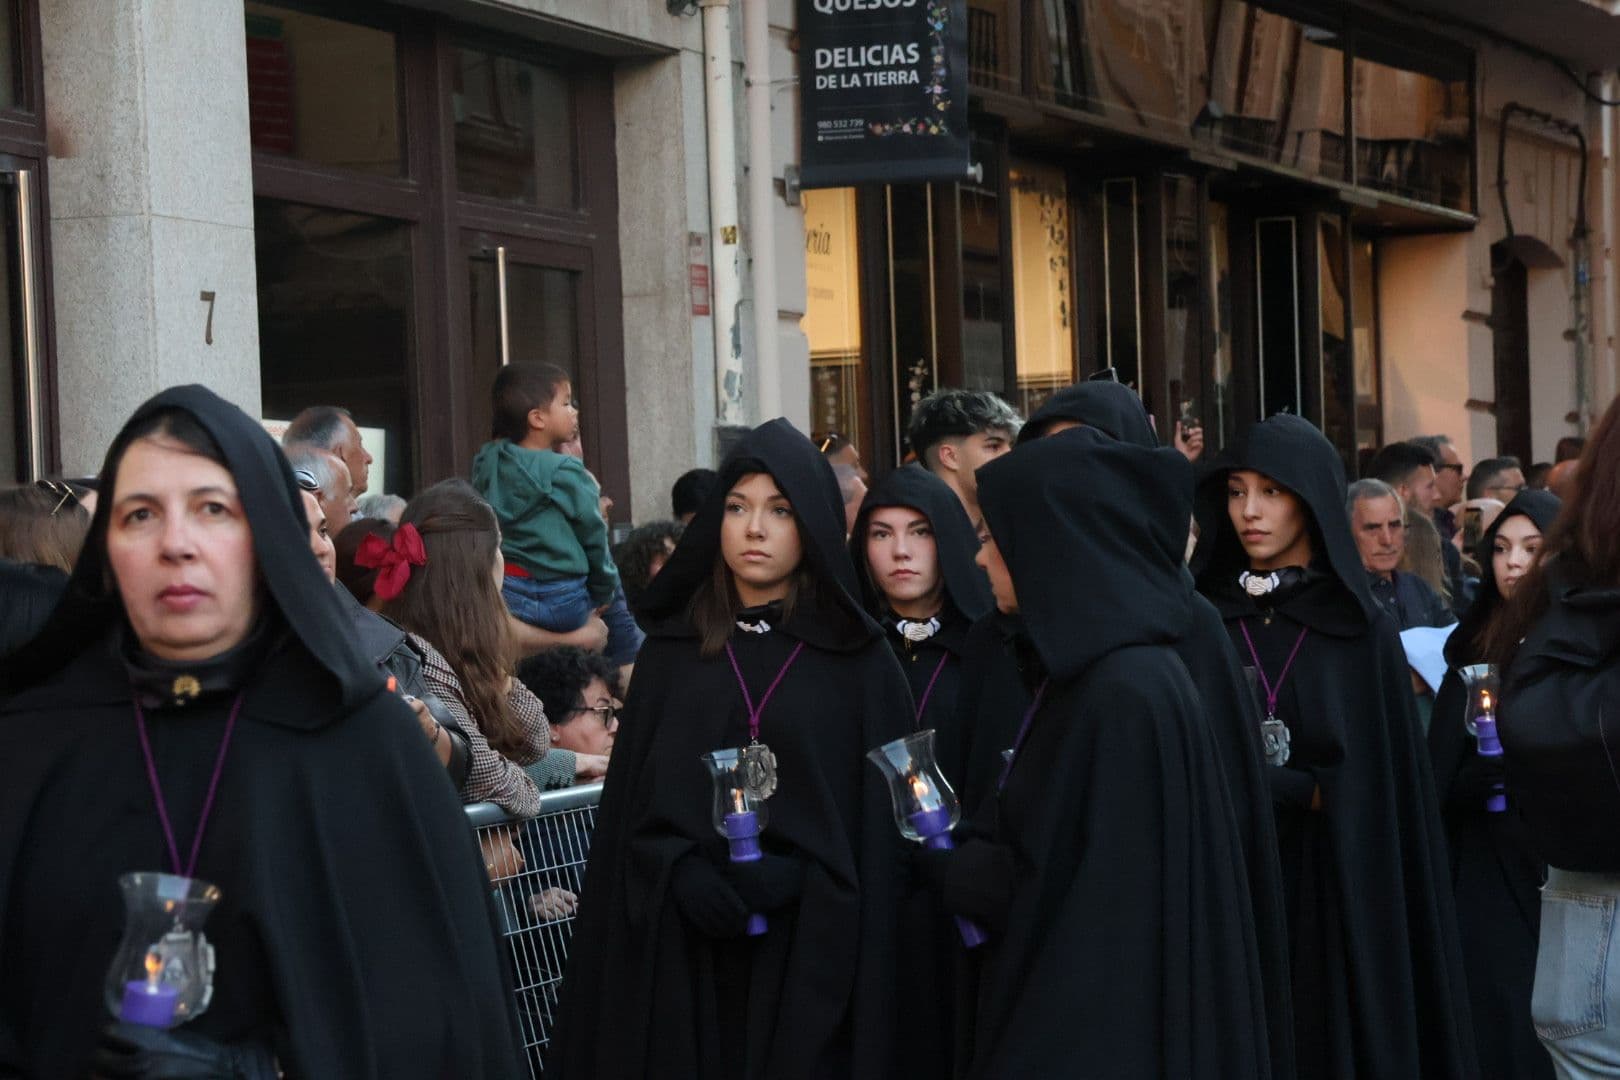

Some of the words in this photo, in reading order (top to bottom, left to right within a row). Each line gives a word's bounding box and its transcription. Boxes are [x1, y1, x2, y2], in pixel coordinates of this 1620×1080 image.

[815, 43, 920, 69] DELICIAS
[816, 74, 837, 89] DE
[841, 73, 861, 88] LA
[863, 69, 920, 87] TIERRA
[200, 291, 216, 345] 7
